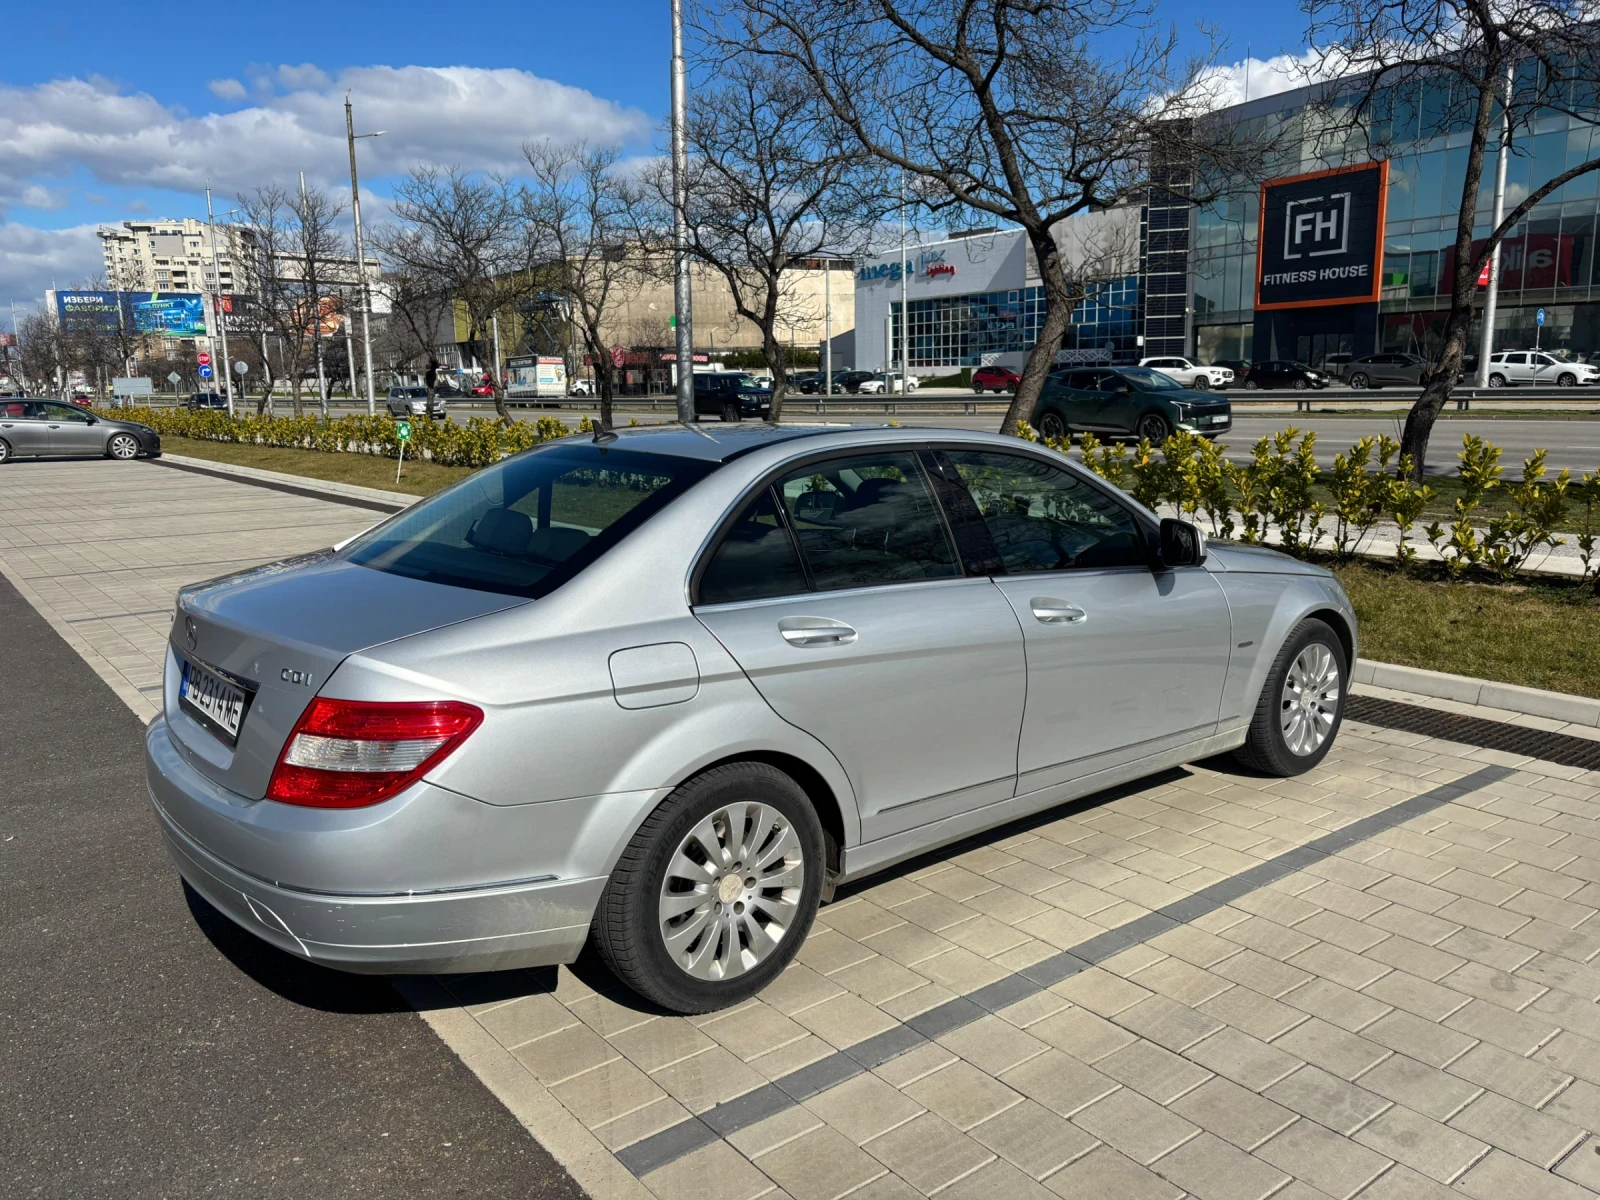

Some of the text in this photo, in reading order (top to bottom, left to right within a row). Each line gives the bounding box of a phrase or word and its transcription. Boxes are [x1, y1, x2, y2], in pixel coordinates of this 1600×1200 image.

[1295, 209, 1338, 244] FH
[861, 260, 915, 280] mega
[1264, 264, 1368, 286] FITNESS HOUSE
[63, 296, 104, 304] ИЗБЕРИ
[65, 304, 120, 313] ФАВОРИТА
[281, 668, 312, 687] CDI
